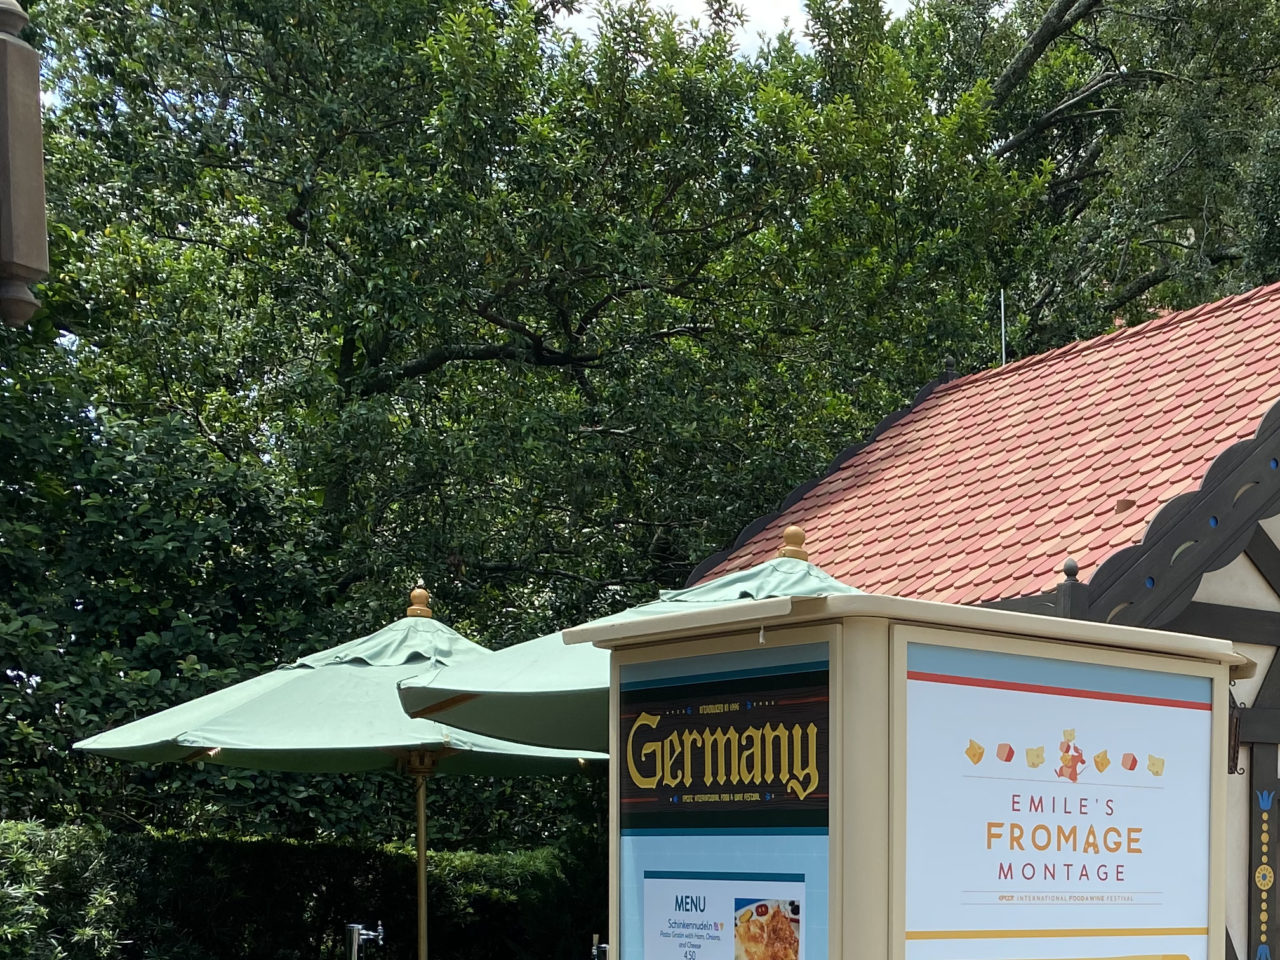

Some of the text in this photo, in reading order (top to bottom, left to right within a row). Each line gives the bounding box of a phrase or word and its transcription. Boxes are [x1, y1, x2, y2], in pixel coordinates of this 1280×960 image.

[627, 712, 819, 801] Germany
[1012, 794, 1114, 816] EMILE'S
[986, 821, 1143, 854] FROMAGE
[998, 862, 1125, 881] MONTAGE
[674, 895, 706, 913] MENU
[667, 918, 713, 931] Schinkennudeln
[684, 951, 696, 960] 4.50
